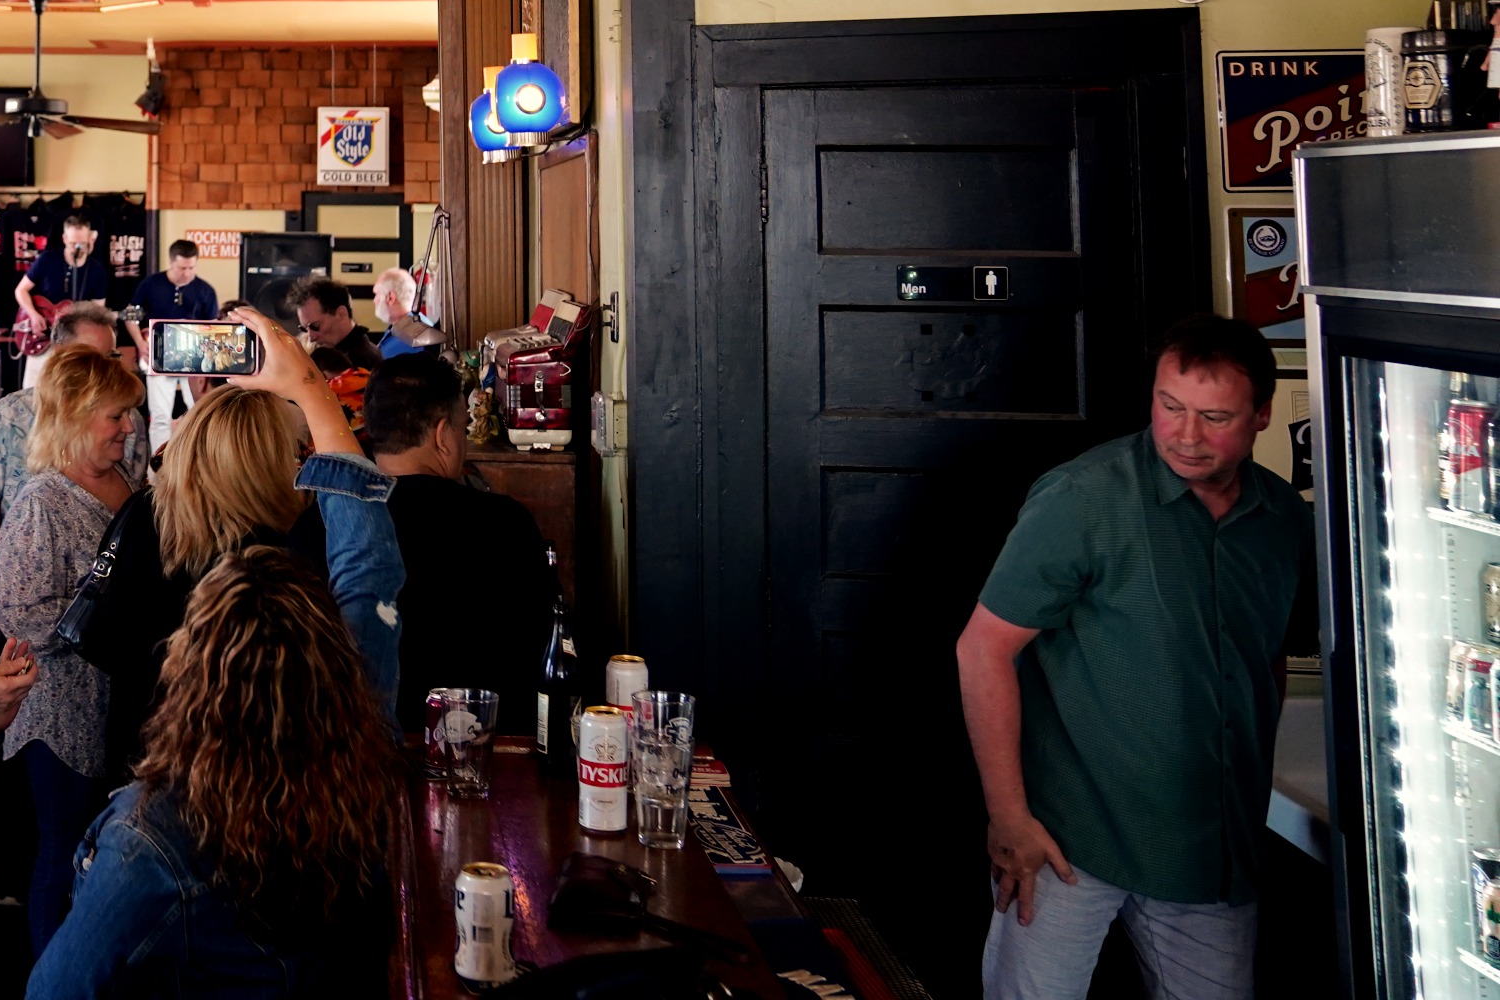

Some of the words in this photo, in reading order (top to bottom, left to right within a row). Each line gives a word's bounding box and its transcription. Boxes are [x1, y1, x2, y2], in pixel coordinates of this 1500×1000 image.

[1229, 61, 1320, 77] DRINK
[342, 125, 366, 142] Old
[336, 138, 370, 163] Style
[323, 172, 351, 182] COLD
[356, 172, 383, 183] BEER
[198, 244, 218, 257] IVE
[901, 283, 927, 294] Men
